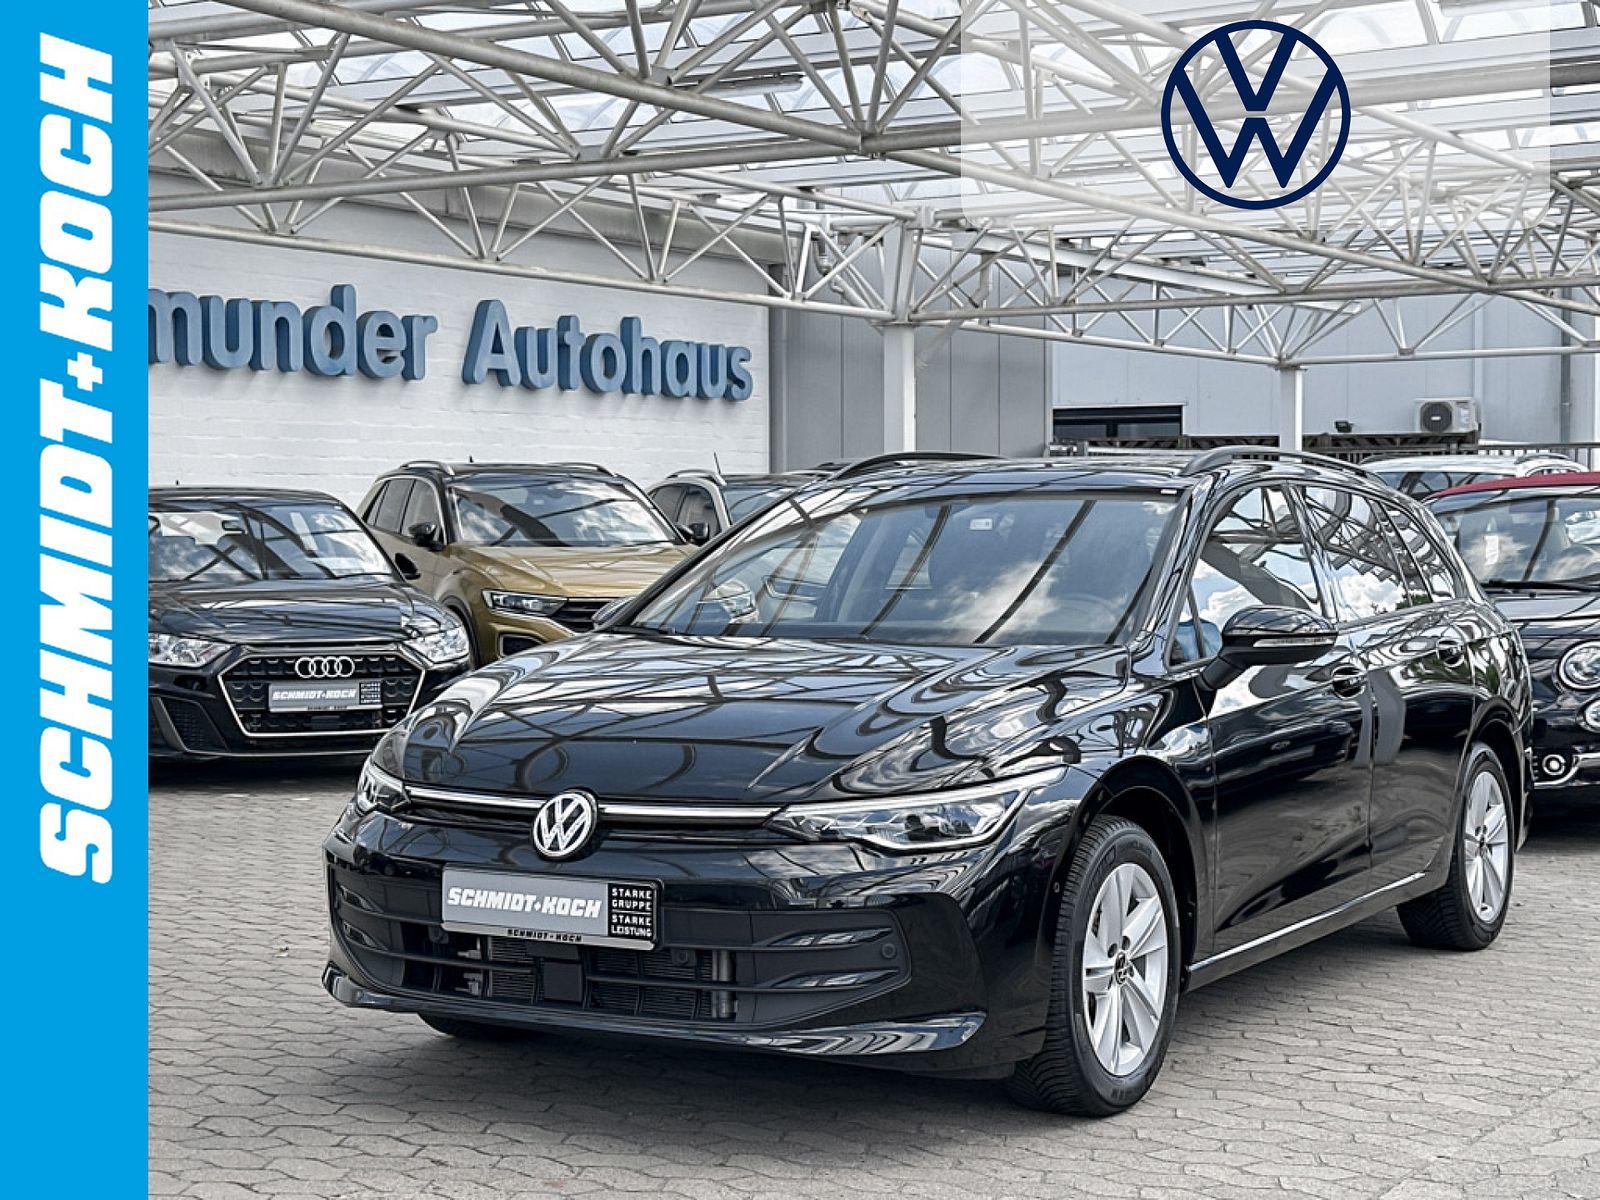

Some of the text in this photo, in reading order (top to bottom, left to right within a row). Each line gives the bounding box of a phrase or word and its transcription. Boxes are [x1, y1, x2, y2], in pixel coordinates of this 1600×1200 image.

[462, 300, 753, 401] Autohaus
[611, 888, 652, 899] STARKE
[447, 887, 602, 919] SCHMIDT+KOCH
[611, 899, 652, 911] GRUPPE
[611, 914, 652, 926] STARKE
